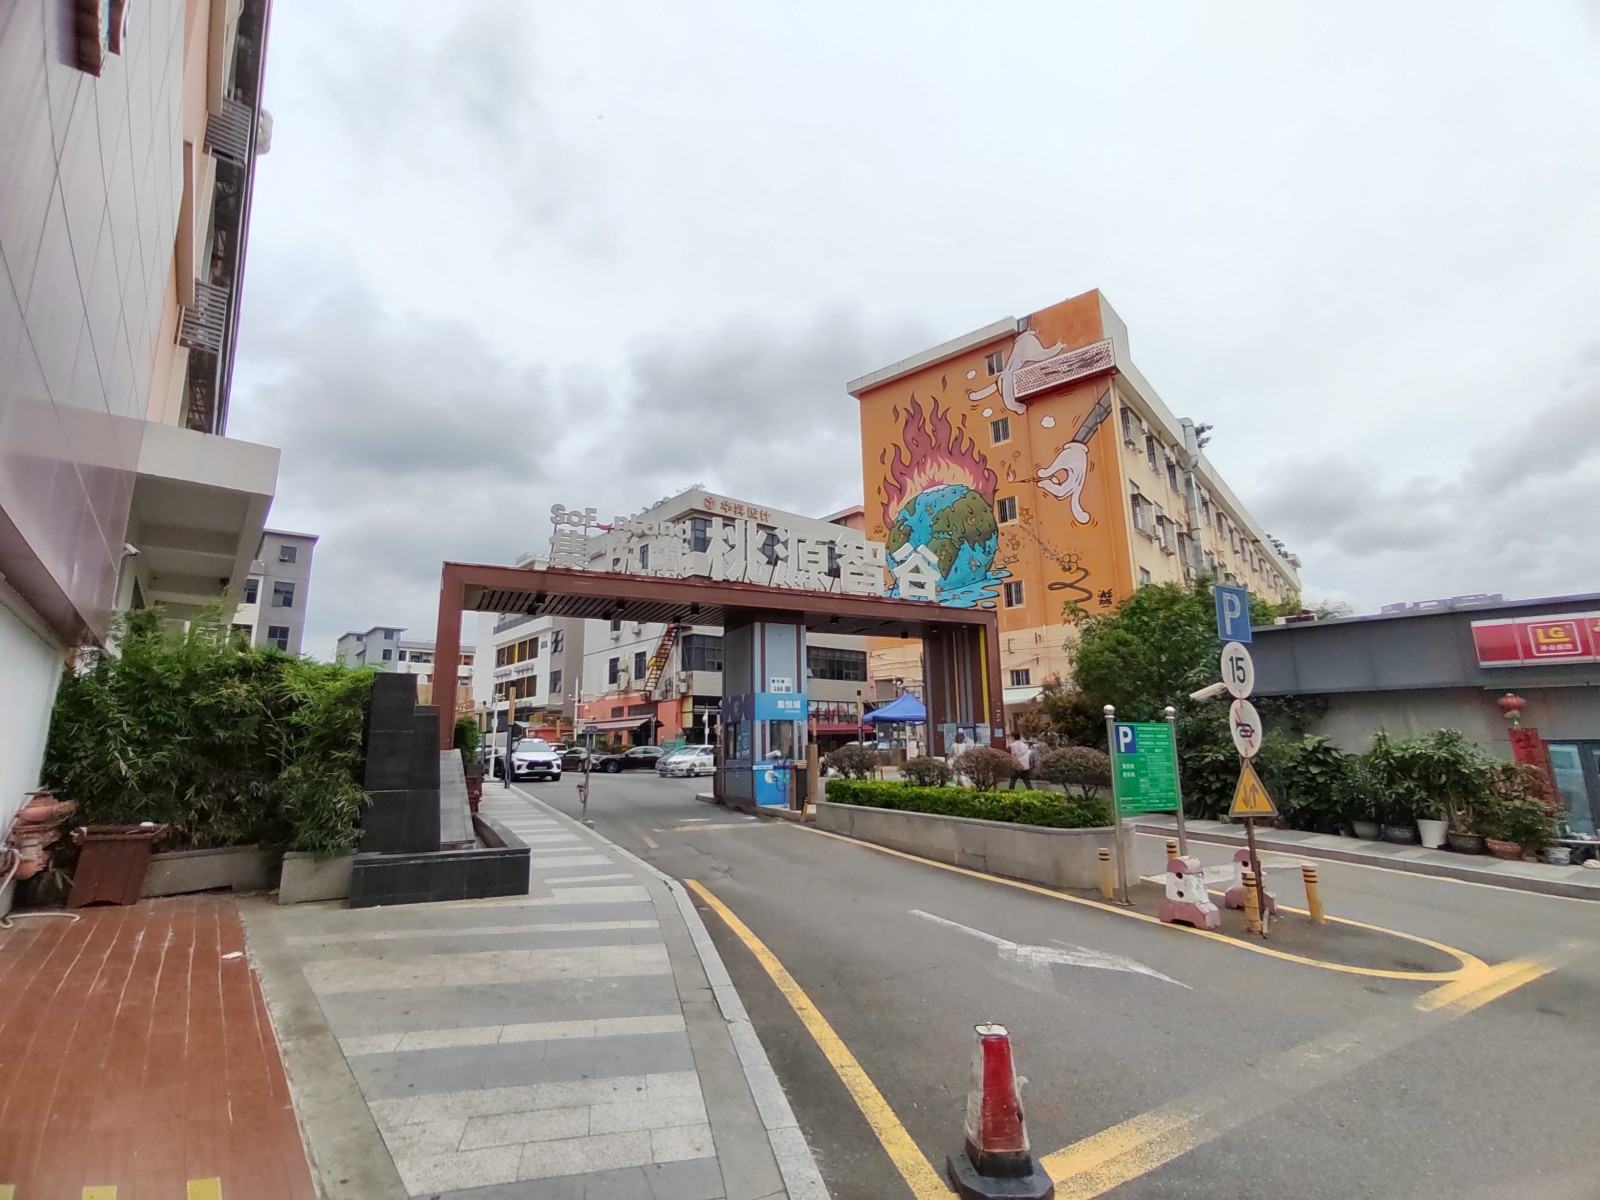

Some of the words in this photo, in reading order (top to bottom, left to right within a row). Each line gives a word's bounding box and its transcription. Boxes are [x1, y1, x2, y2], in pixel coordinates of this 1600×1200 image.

[706, 517, 941, 600] 桃源智谷
[1222, 592, 1241, 635] P
[1229, 656, 1246, 684] 15
[1118, 726, 1132, 753] P
